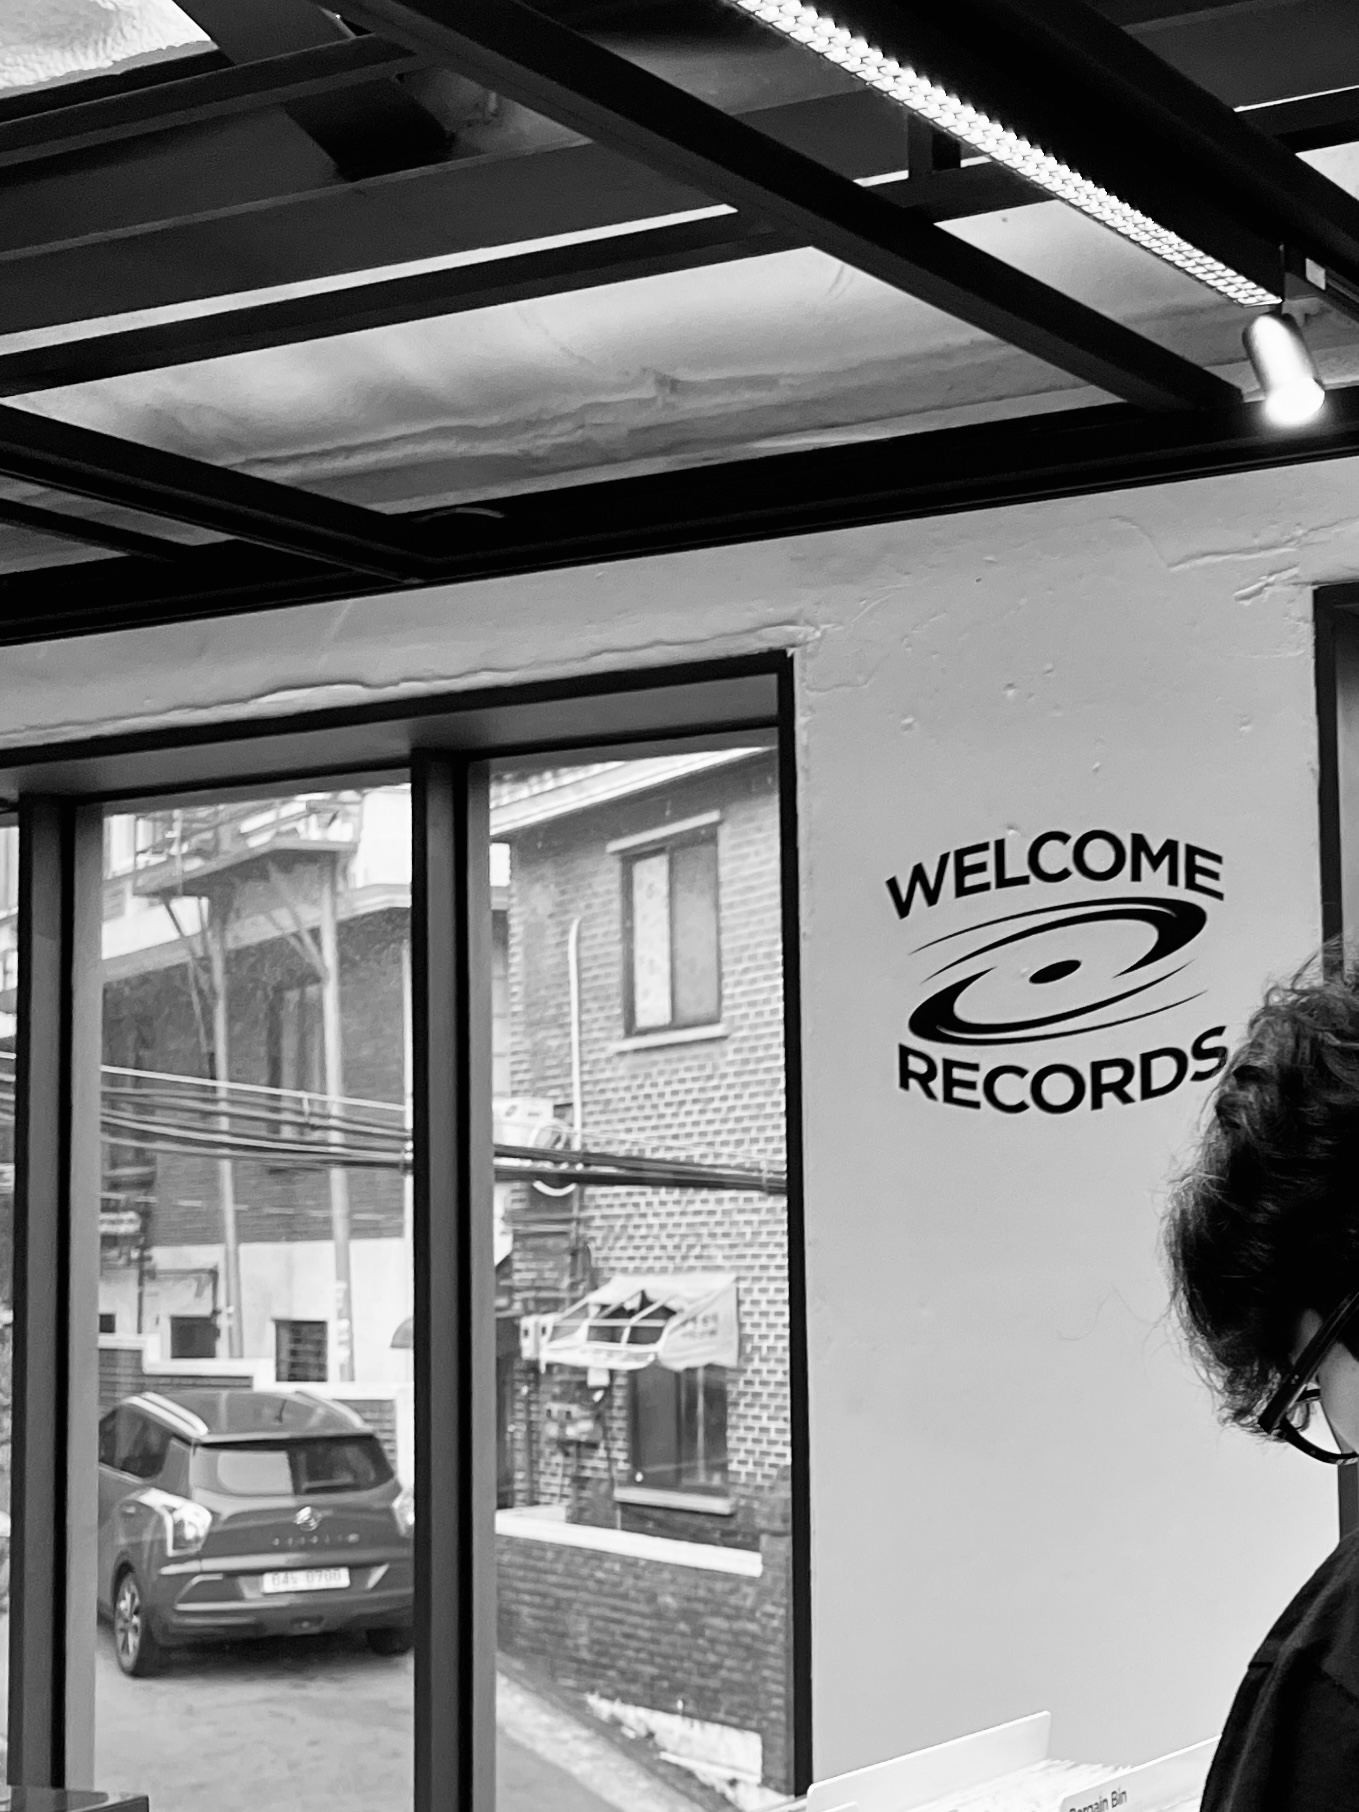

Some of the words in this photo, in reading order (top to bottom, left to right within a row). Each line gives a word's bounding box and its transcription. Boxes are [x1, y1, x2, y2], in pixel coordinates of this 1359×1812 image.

[886, 829, 1224, 920] WELCOME
[897, 1025, 1229, 1114] RECORDS
[1111, 1786, 1128, 1809] Bin
